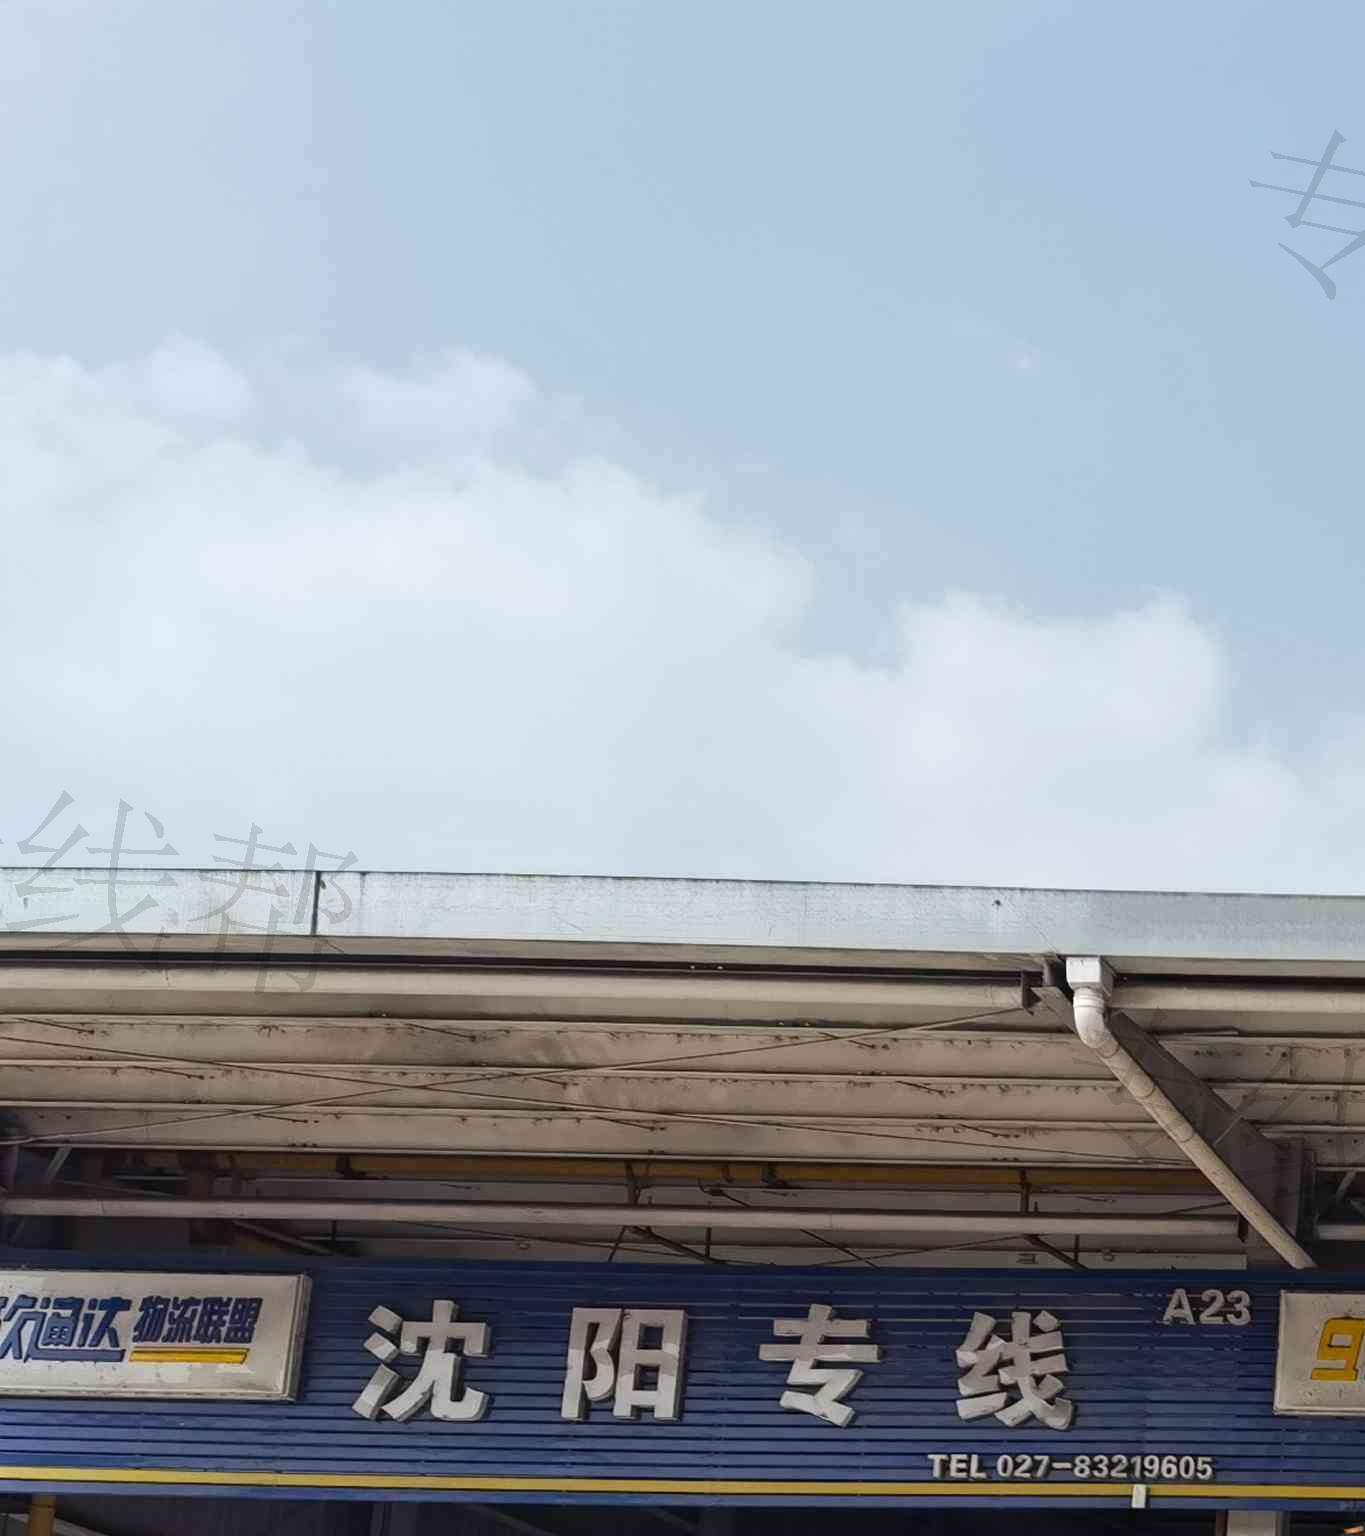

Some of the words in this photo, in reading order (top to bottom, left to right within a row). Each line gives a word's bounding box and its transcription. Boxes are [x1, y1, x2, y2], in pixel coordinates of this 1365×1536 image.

[133, 1296, 263, 1344] 物流联盟
[1162, 1289, 1251, 1327] A23
[352, 1299, 1075, 1430] 沈阳专线
[928, 1454, 986, 1479] TEL
[996, 1455, 1213, 1481] 027-83219605
